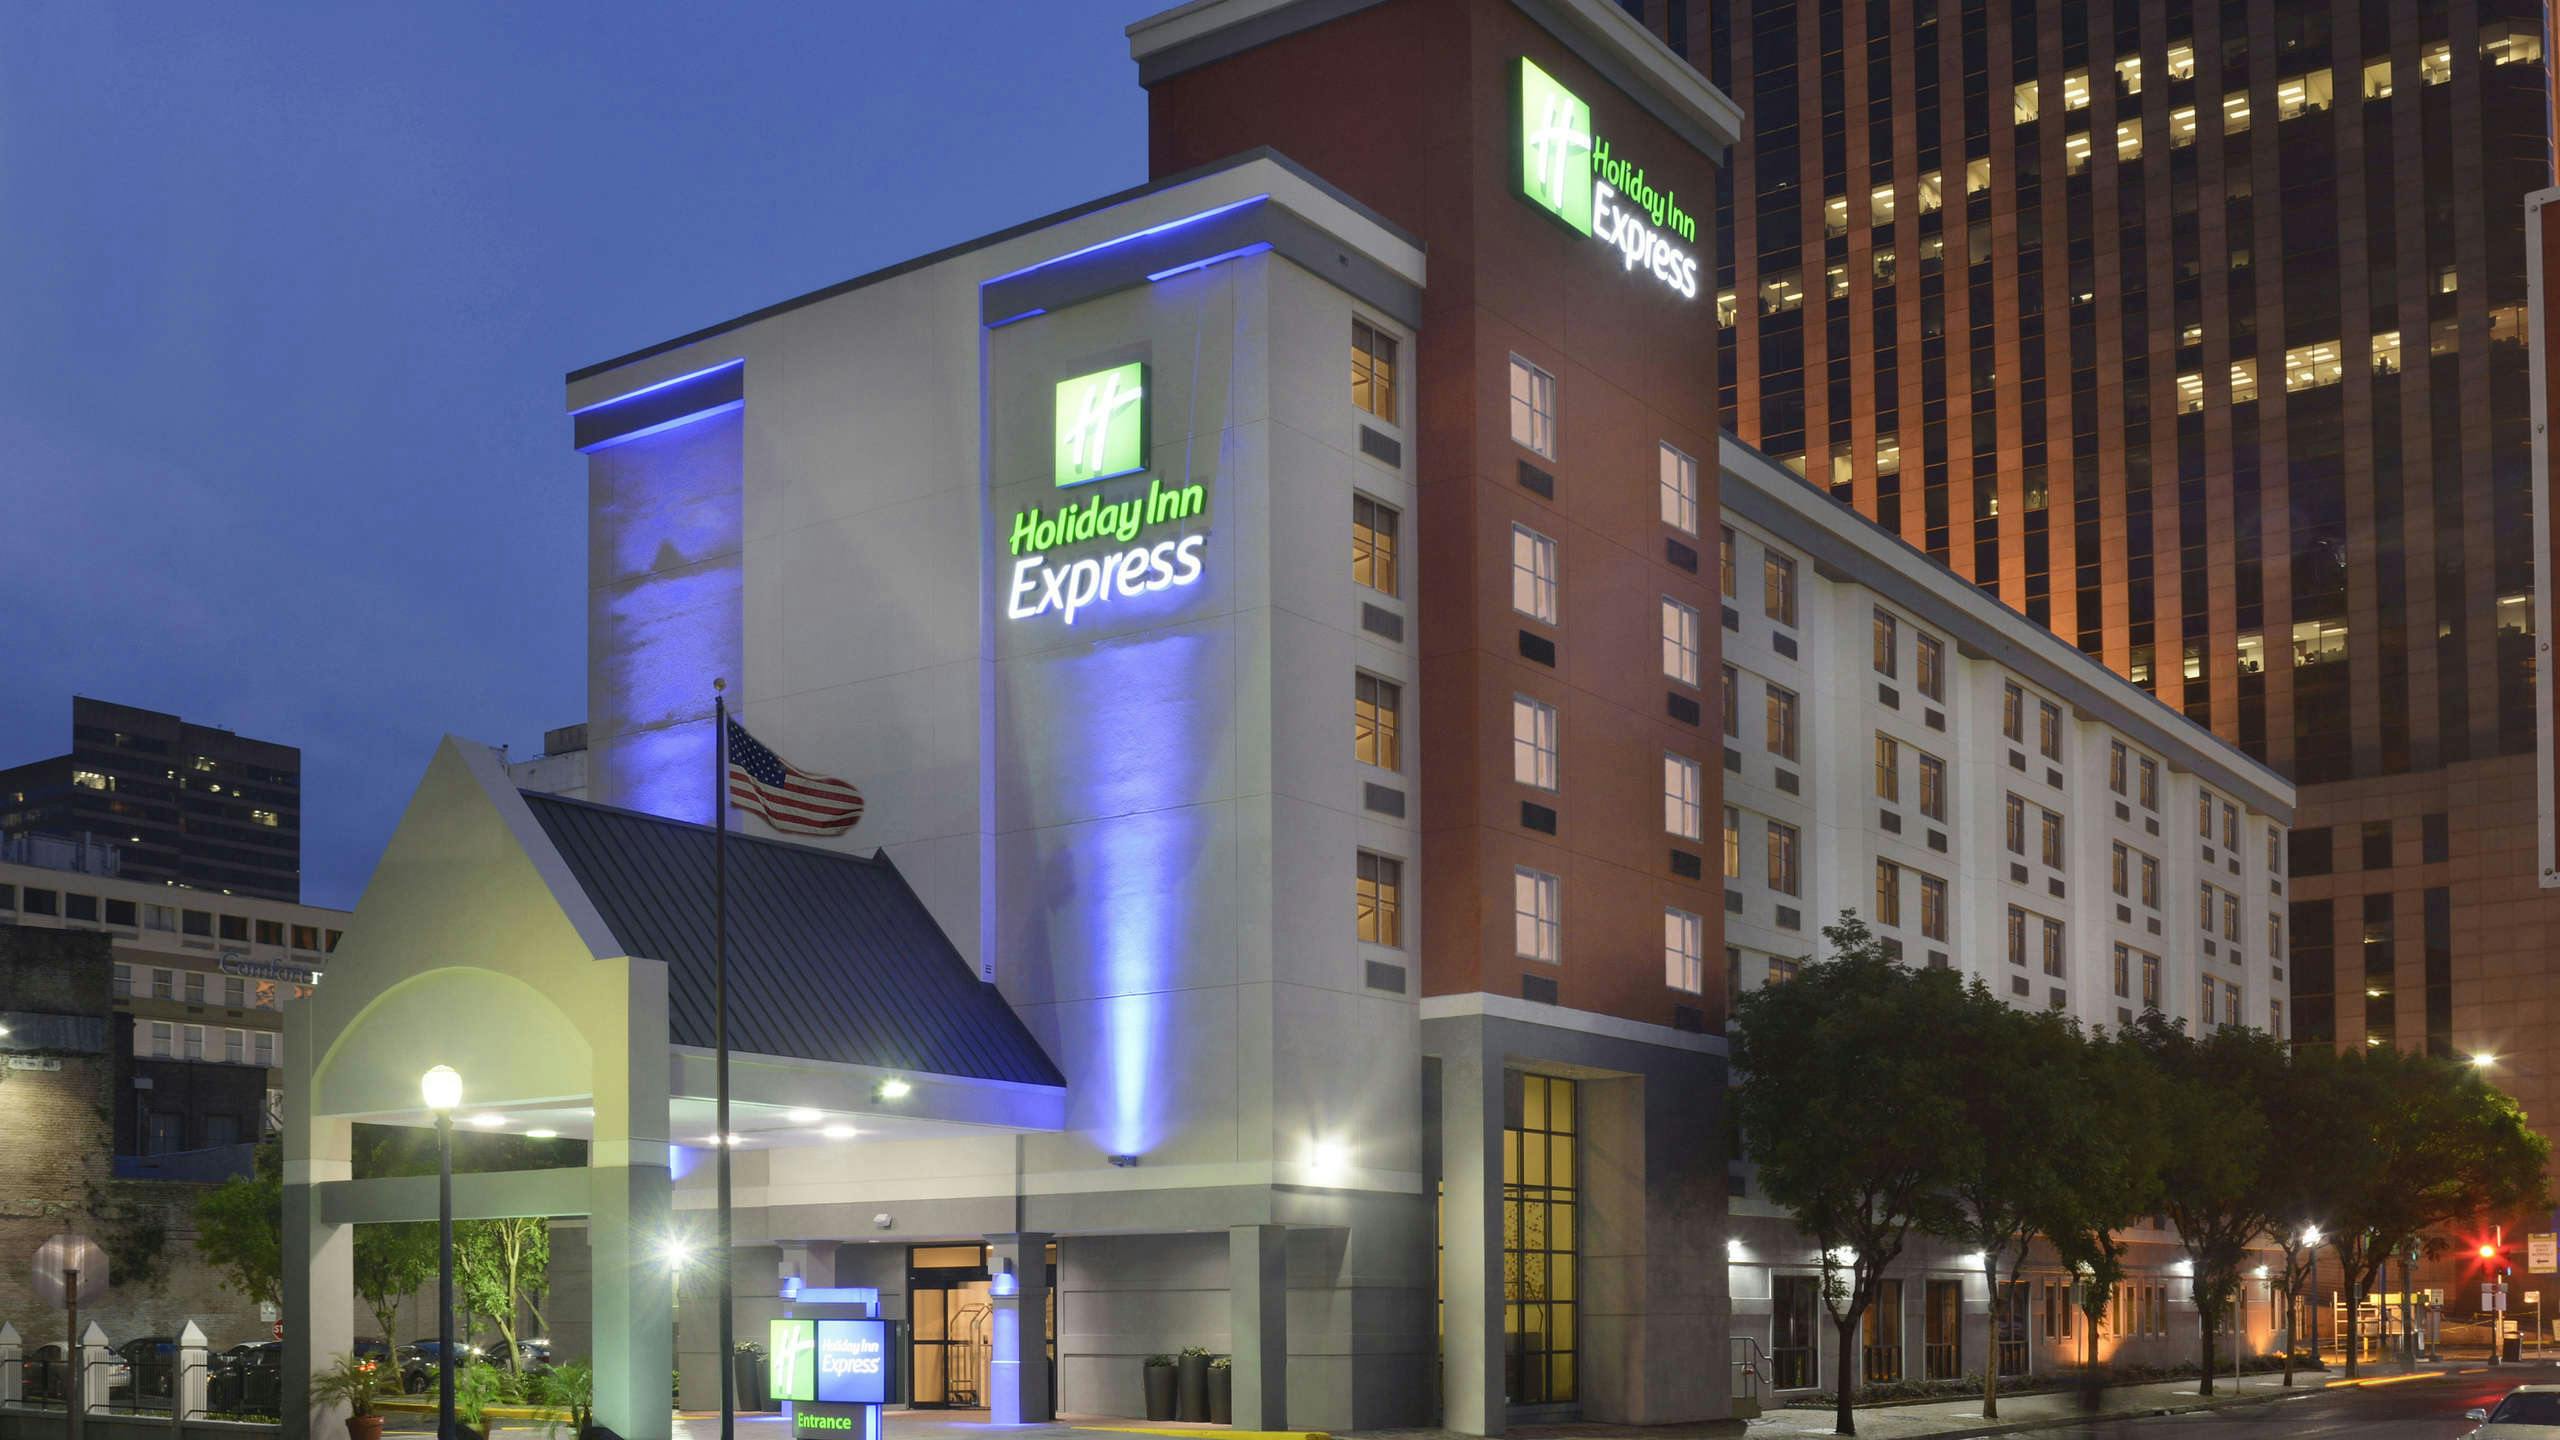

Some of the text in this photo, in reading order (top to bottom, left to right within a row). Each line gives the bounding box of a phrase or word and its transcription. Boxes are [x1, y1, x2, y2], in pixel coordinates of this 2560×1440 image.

[1593, 135, 1696, 243] Holiday Inn
[1592, 180, 1697, 298] Express
[1009, 479, 1205, 556] Holiday Inn
[1007, 534, 1204, 626] Express
[822, 1338, 880, 1355] Holiday Inn
[822, 1354, 879, 1377] Express
[797, 1412, 852, 1430] Entrance
